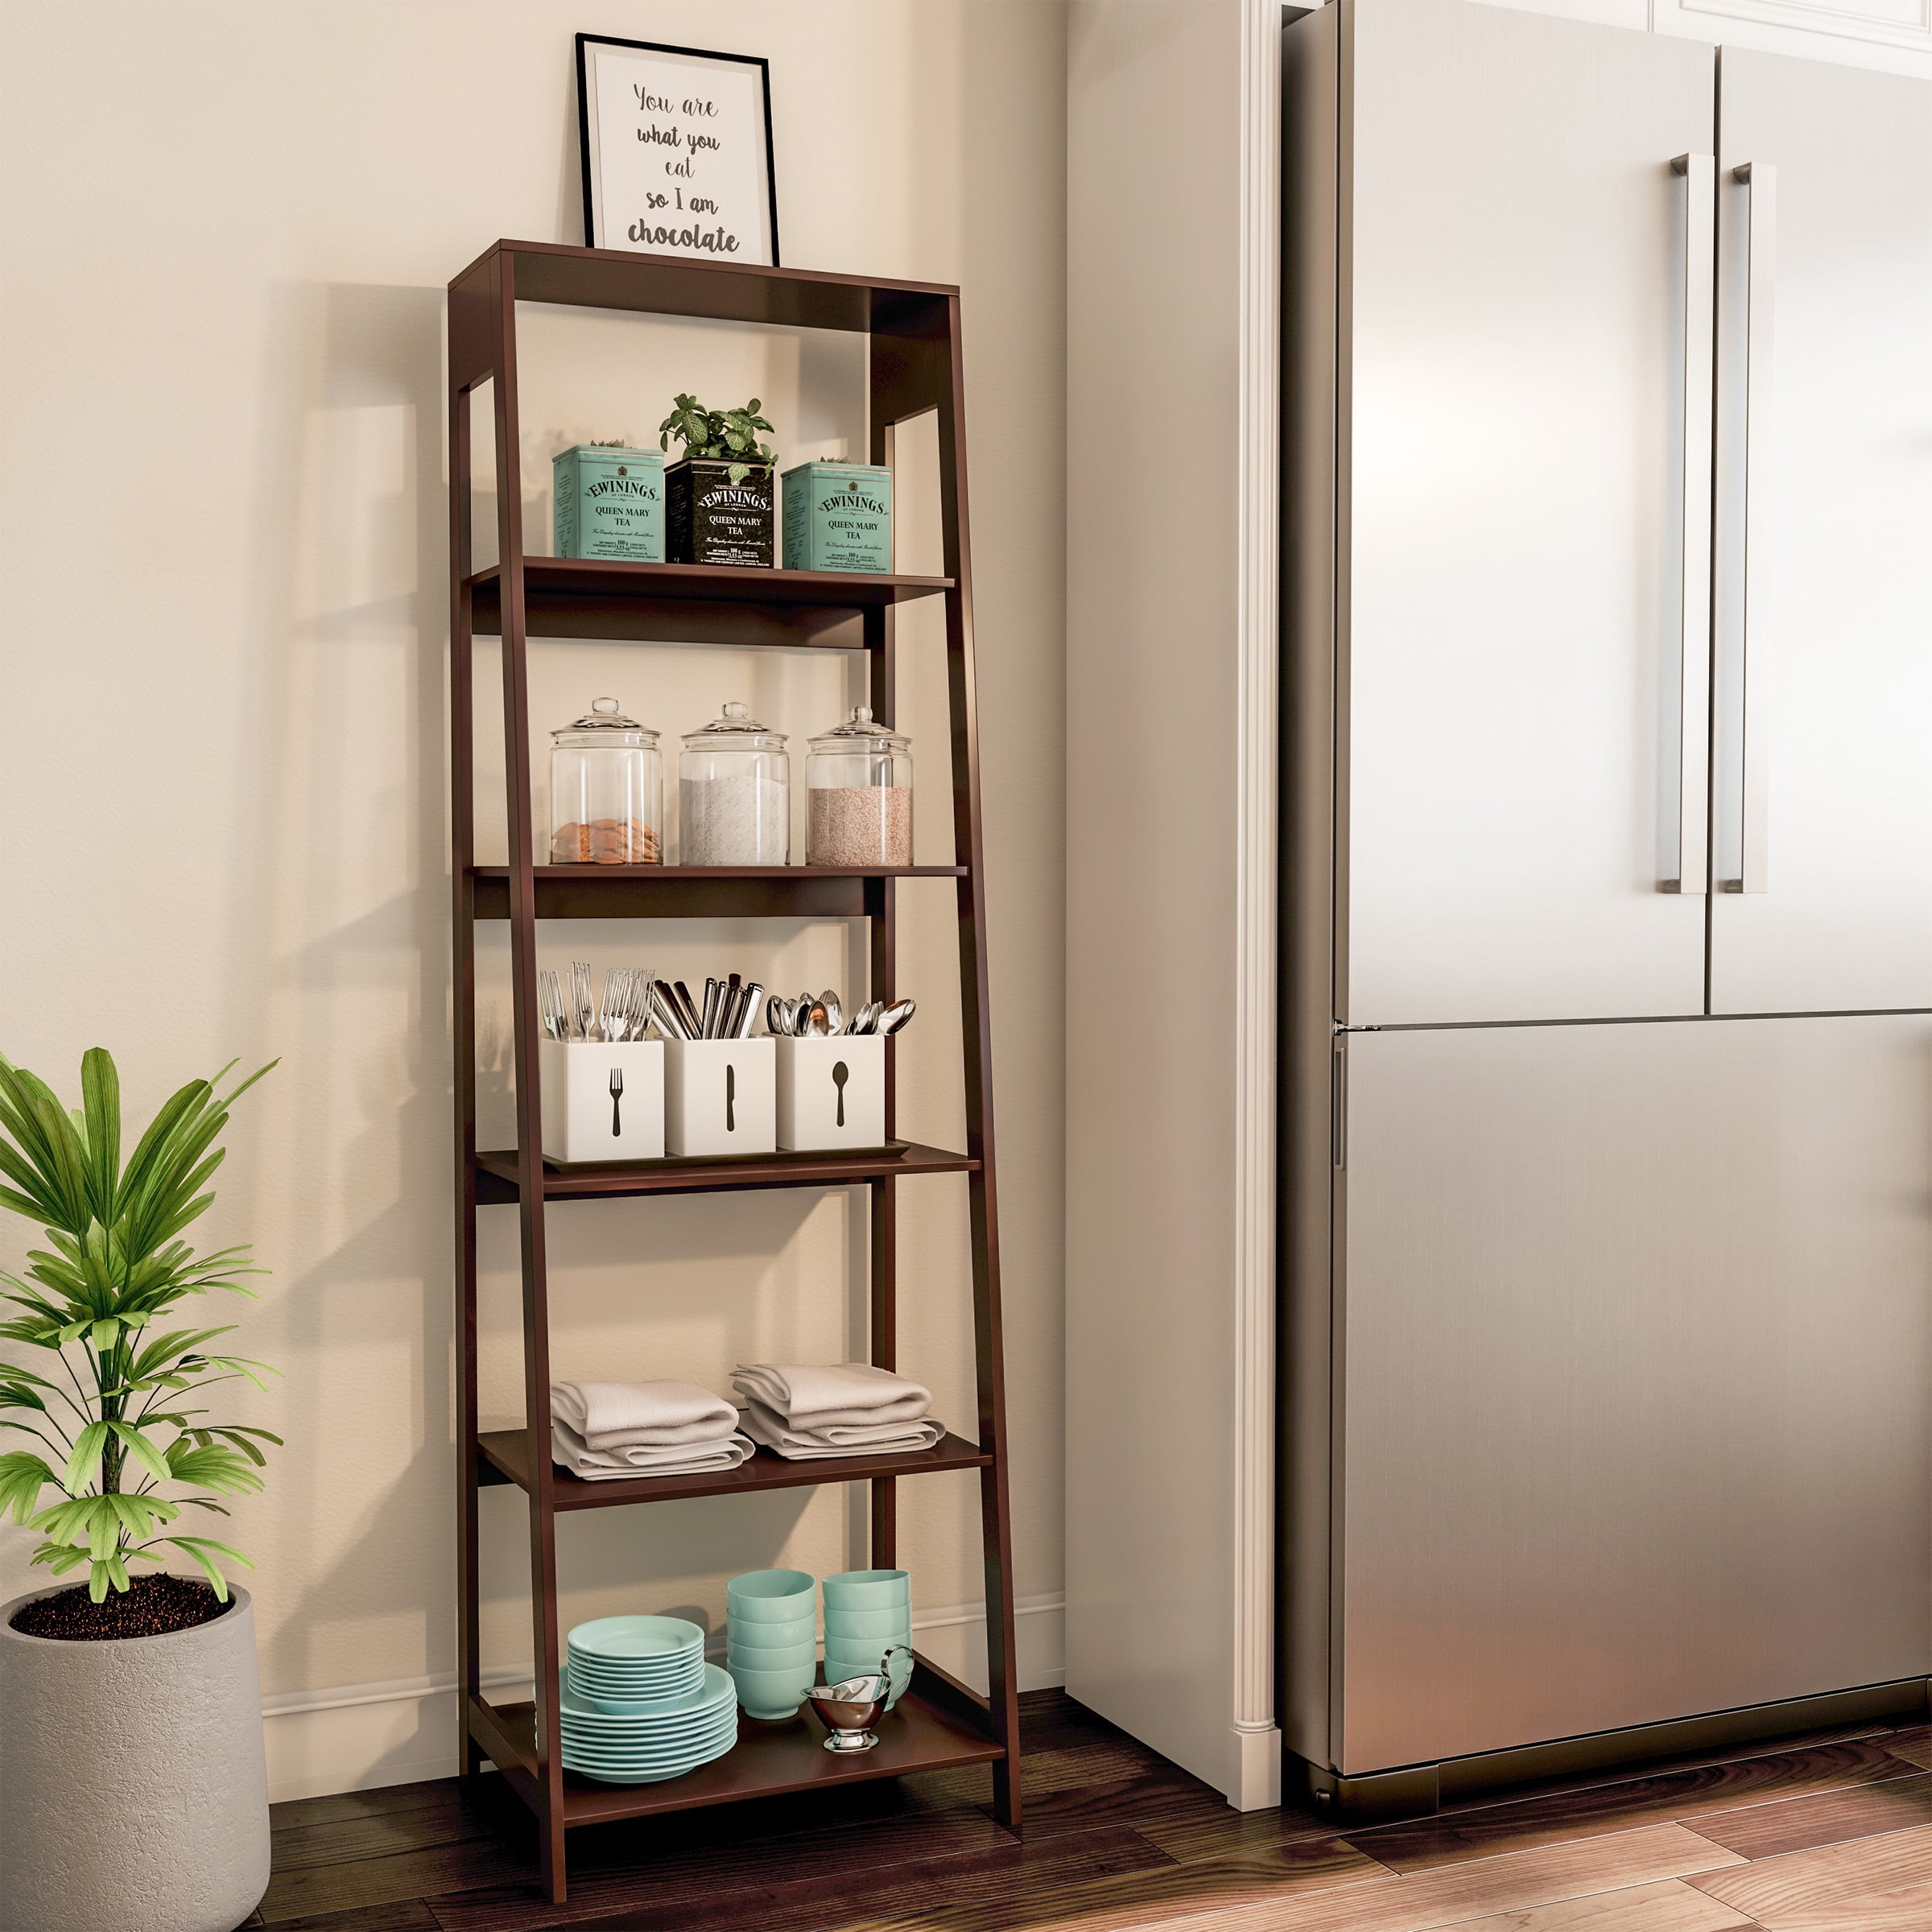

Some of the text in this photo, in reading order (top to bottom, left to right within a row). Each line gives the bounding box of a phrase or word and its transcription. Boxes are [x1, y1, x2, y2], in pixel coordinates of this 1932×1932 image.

[634, 83, 719, 118] You are
[637, 123, 720, 155] what you
[665, 156, 696, 179] eat
[646, 187, 719, 215] so I am
[628, 217, 740, 253] chocolate
[595, 506, 650, 517] QUEEN MARY
[614, 518, 631, 526] TEA
[709, 515, 762, 526] QUEEN MARY
[828, 520, 879, 530] QUEEN MARY
[728, 526, 743, 535] TEA
[845, 531, 861, 539] TEA
